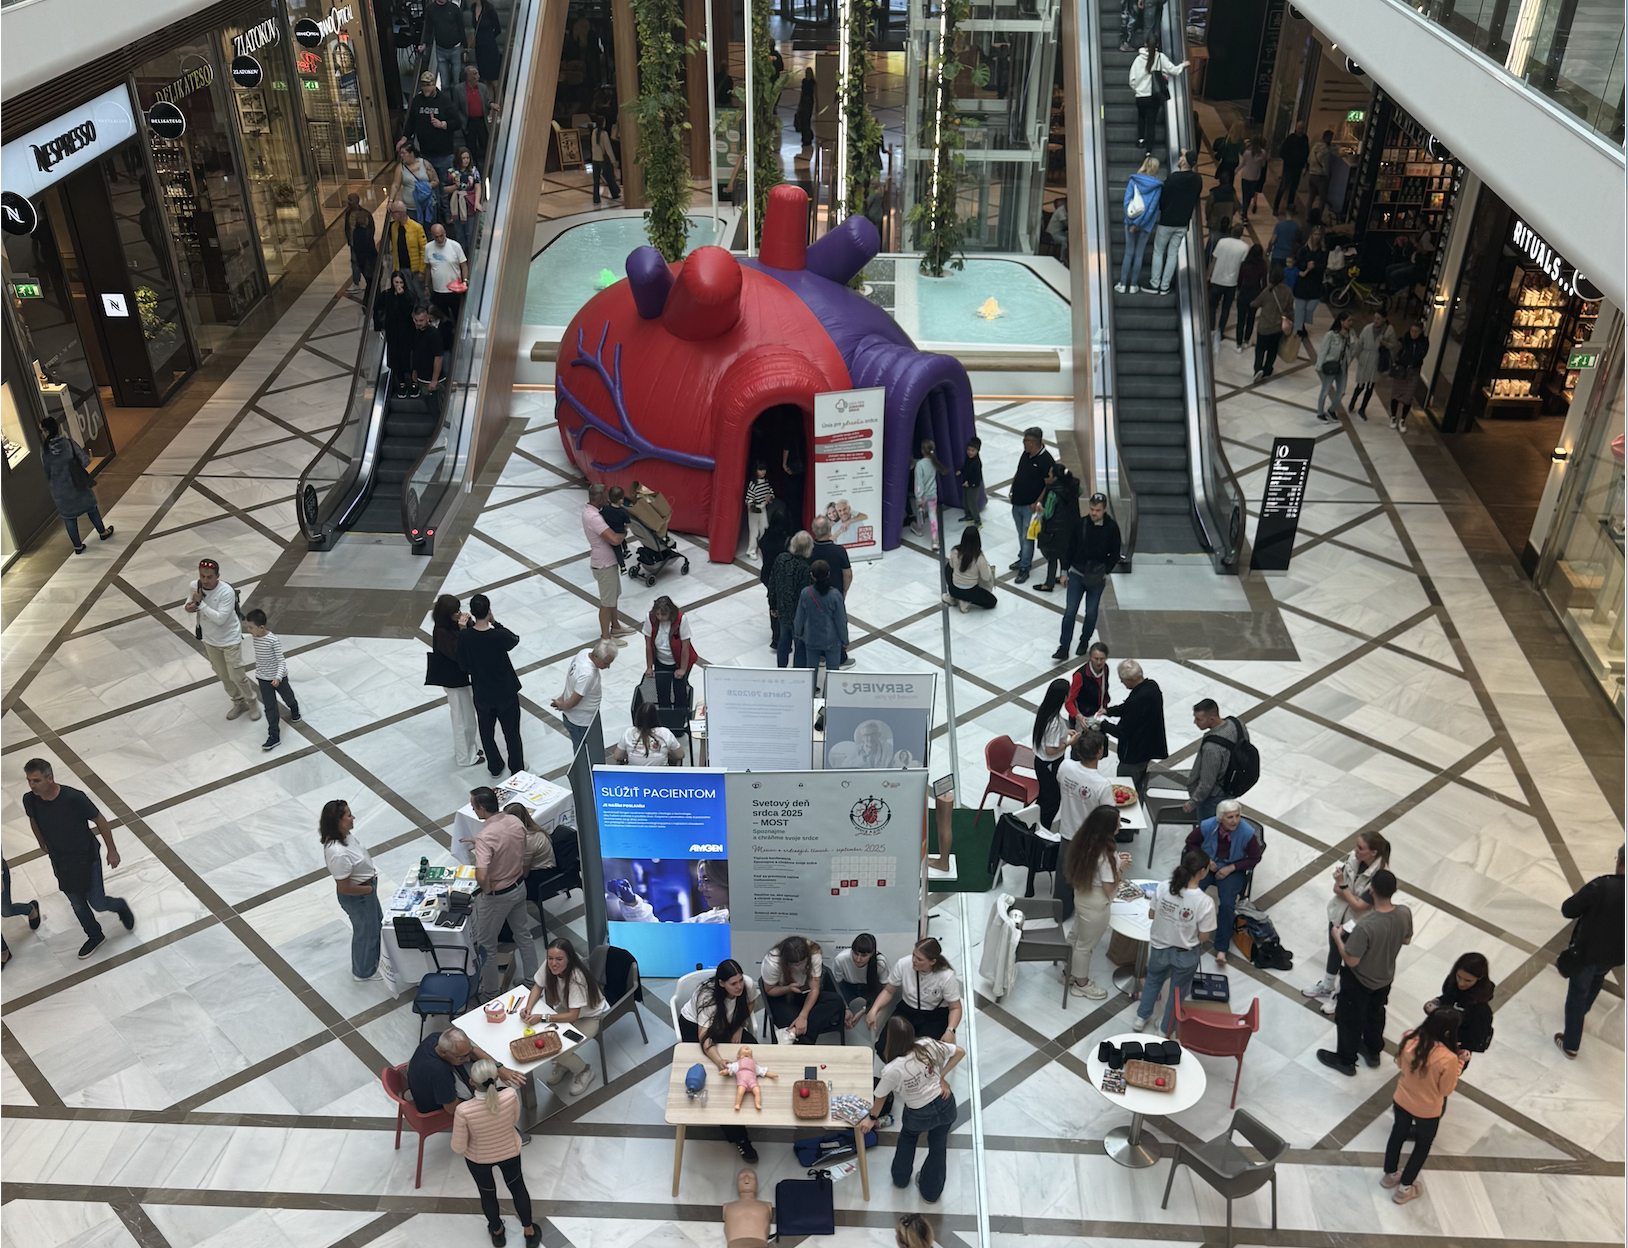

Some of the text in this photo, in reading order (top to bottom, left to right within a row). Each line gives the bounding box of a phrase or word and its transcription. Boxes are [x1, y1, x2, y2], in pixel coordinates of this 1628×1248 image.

[234, 17, 277, 56] ZLATOKOV
[155, 64, 212, 104] DELIKATESO
[29, 120, 97, 172] NESPRESSO
[601, 785, 716, 799] SLÚŽIŤ PACIENTOM
[752, 798, 810, 809] Svetový deň
[752, 809, 803, 817] srdca 2025
[760, 818, 789, 827] MOST
[689, 844, 724, 852] AMGEN
[864, 843, 886, 853] 2025
